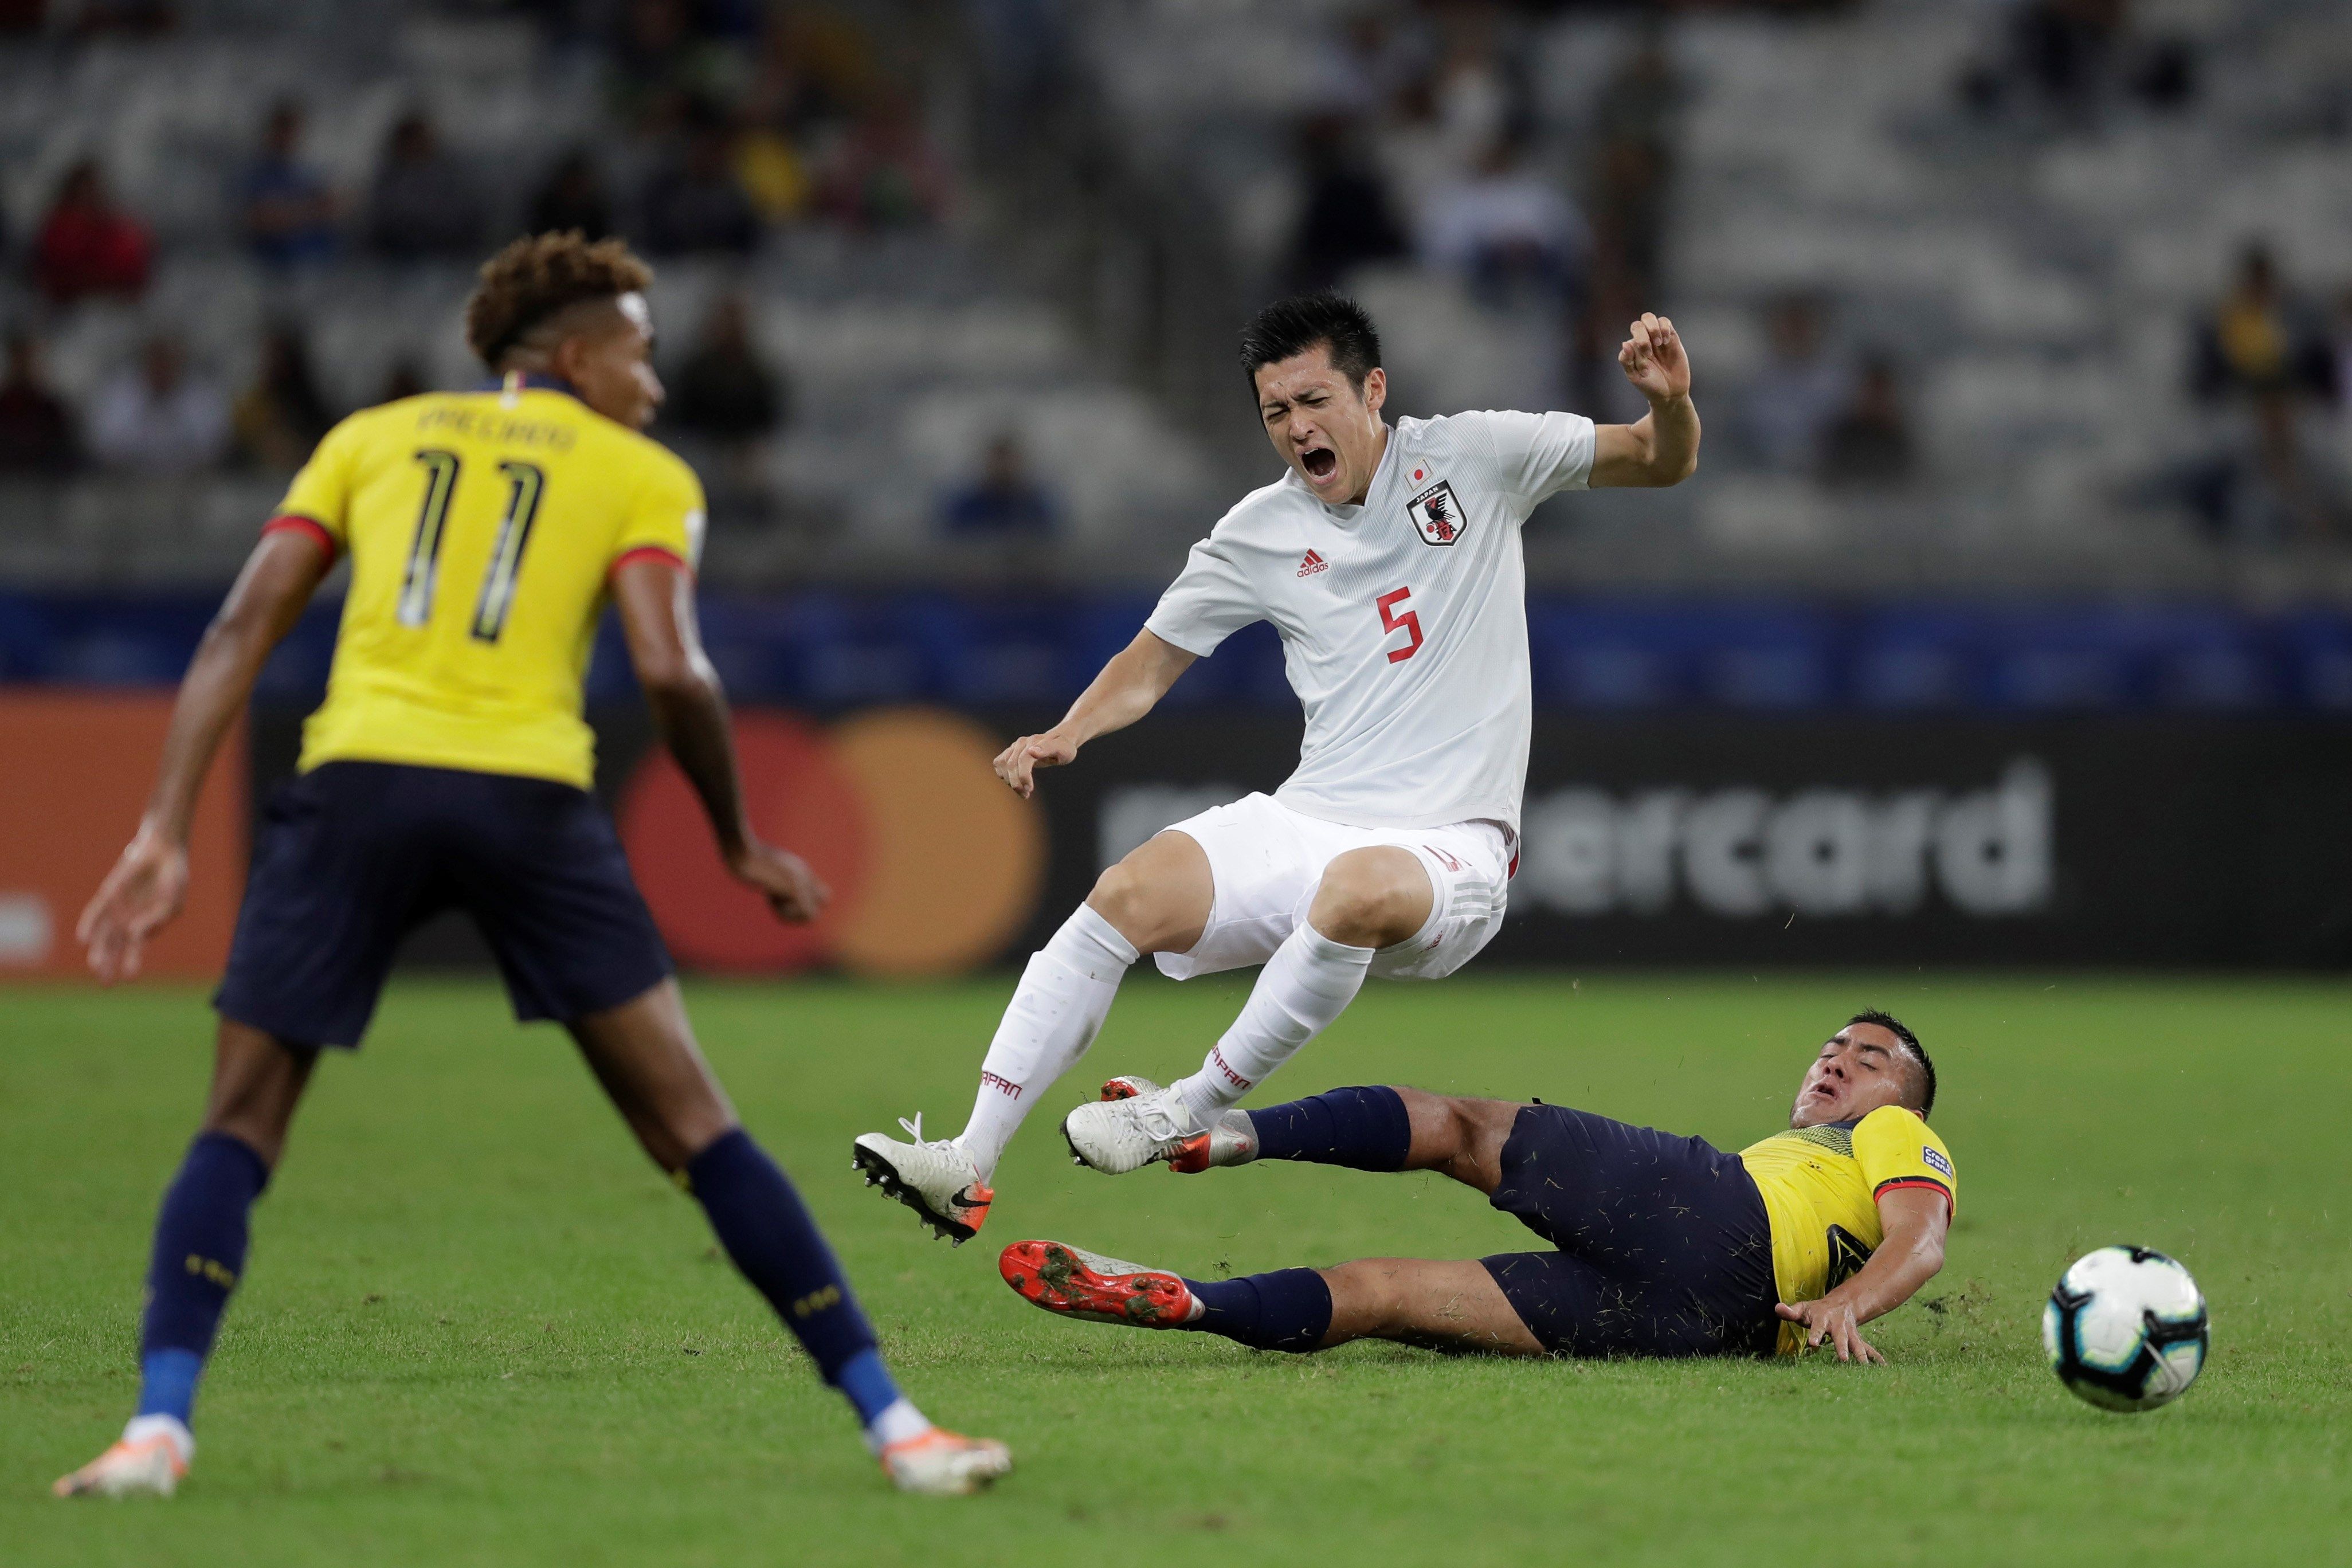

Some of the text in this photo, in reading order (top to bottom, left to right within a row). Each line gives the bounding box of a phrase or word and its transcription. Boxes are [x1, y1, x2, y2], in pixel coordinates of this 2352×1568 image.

[1416, 485, 1439, 503] JAPAN
[397, 449, 544, 643] 11
[1296, 562, 1328, 578] adidas
[1376, 586, 1424, 665] 5
[1212, 1046, 1251, 1089] APAN
[982, 1070, 1022, 1100] APAN
[1926, 1155, 1951, 1177] grand
